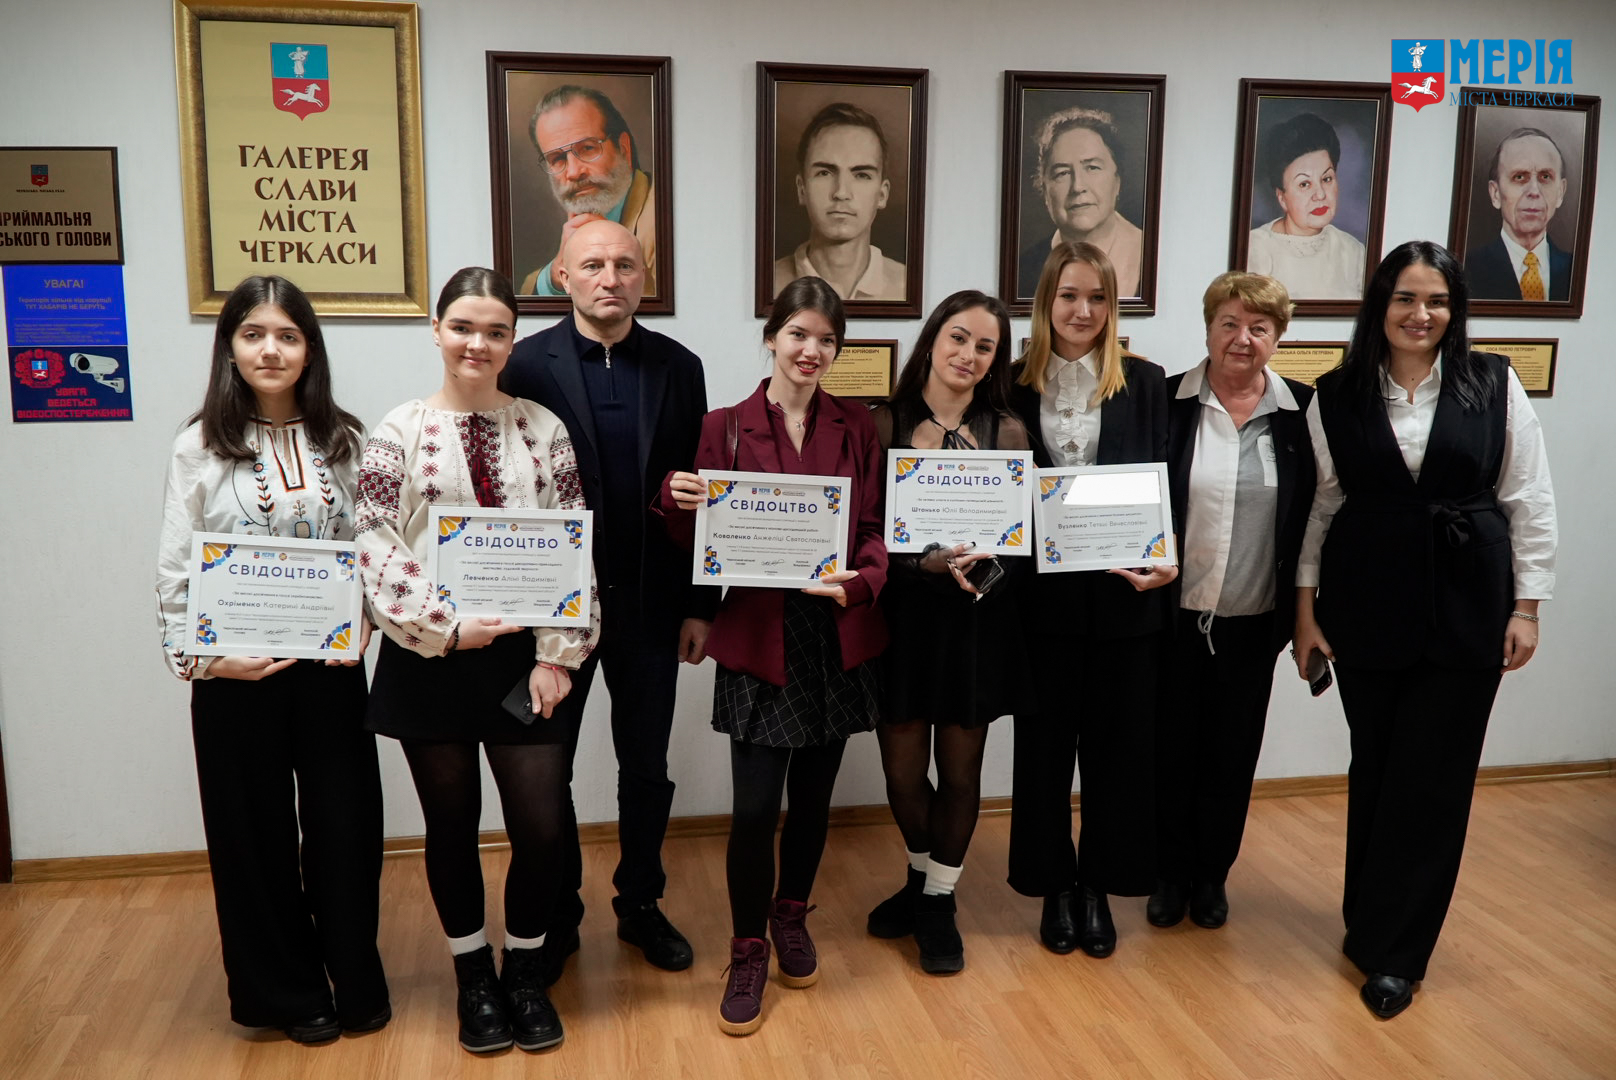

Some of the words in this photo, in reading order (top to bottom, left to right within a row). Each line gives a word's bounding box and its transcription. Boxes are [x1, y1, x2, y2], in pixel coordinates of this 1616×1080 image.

[238, 145, 368, 171] ГАЛЕРЕЯ
[254, 177, 357, 202] СЛАВИ
[0, 210, 92, 226] РИЙМАЛЬНЯ
[56, 232, 112, 246] ГОЛОВИ
[239, 240, 376, 265] ЧЕРКАСИ
[44, 280, 84, 288] УВАГА!
[56, 388, 86, 396] УВАГА
[48, 398, 96, 407] ВЕДЕТЬСЯ
[918, 475, 1002, 486] СВІДОЦТВО
[730, 499, 818, 514] СВІДОЦТВО
[464, 536, 559, 549] СВІДОЦТВО
[785, 536, 831, 544] Святославівні
[228, 564, 329, 580] СВІДОЦТВО
[217, 599, 261, 608] Охріменко
[263, 602, 298, 610] Катерині
